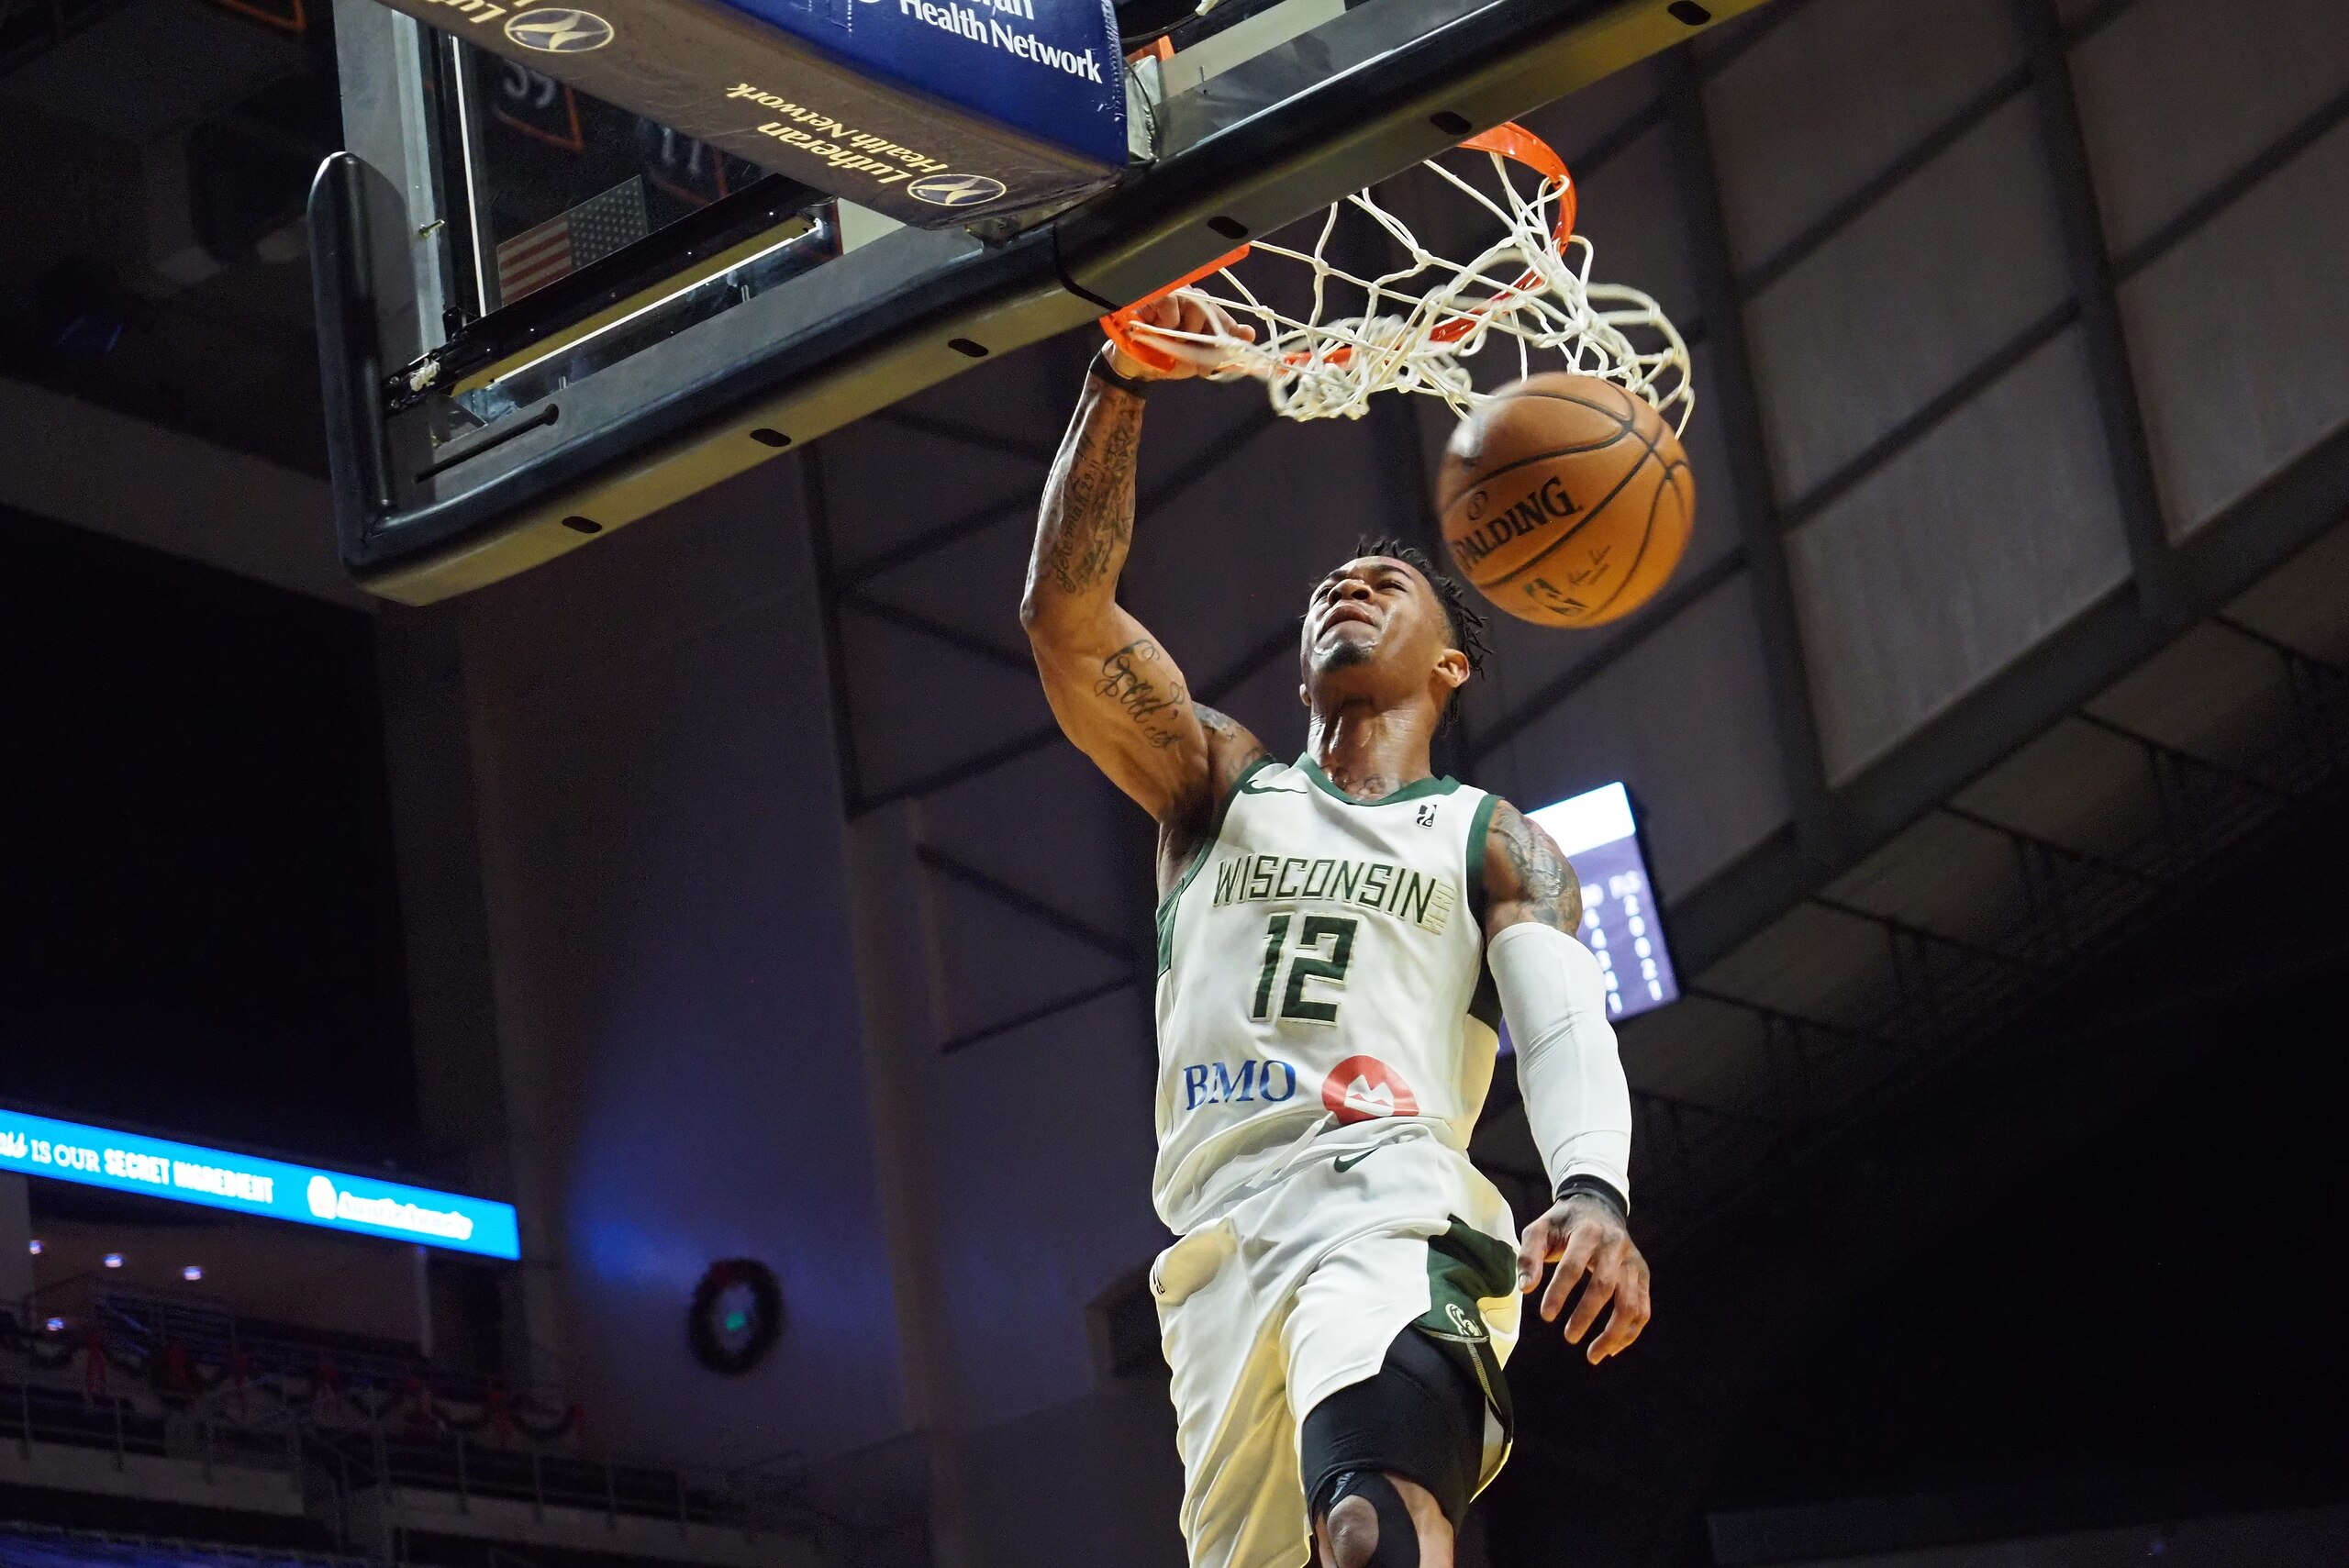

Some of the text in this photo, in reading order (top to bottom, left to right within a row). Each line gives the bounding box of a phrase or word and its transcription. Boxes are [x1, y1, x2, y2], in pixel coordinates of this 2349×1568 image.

[899, 0, 1102, 83] Health Network
[726, 83, 948, 172] Health Network
[757, 122, 913, 183] Lutheran
[1213, 854, 1438, 926] WISCONSIN
[1251, 911, 1358, 1026] 12
[1184, 1060, 1297, 1111] BMO
[30, 1139, 52, 1164] IS
[53, 1144, 101, 1173] OUR
[103, 1148, 171, 1184] SECRET
[173, 1160, 273, 1204] INGREDIENT
